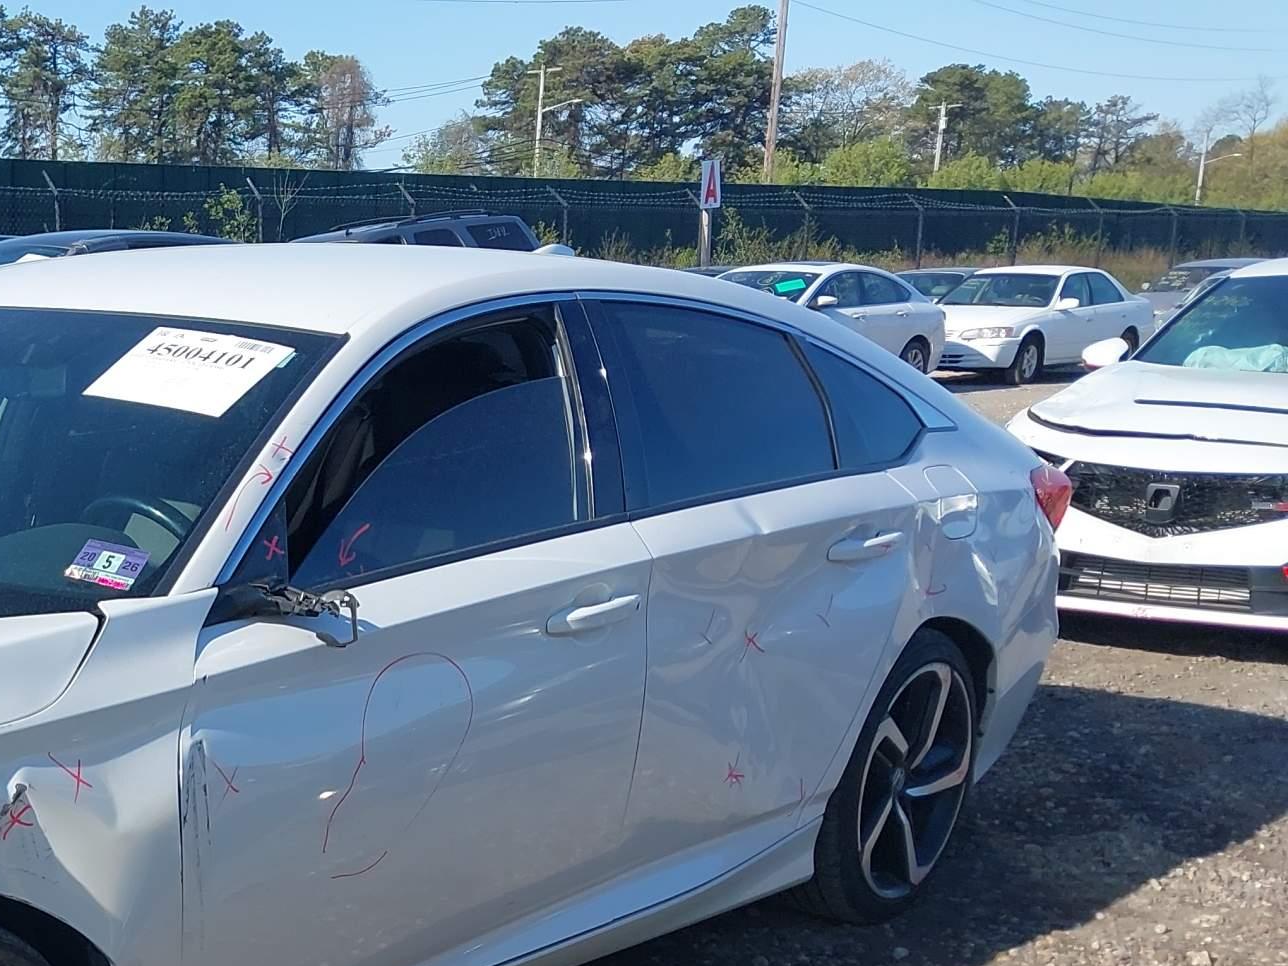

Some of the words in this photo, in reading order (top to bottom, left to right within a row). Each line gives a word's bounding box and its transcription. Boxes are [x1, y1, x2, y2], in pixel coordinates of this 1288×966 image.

[704, 161, 717, 204] A
[146, 342, 255, 369] 45004101
[80, 551, 97, 562] 20
[102, 554, 116, 569] 5
[122, 560, 140, 572] 26
